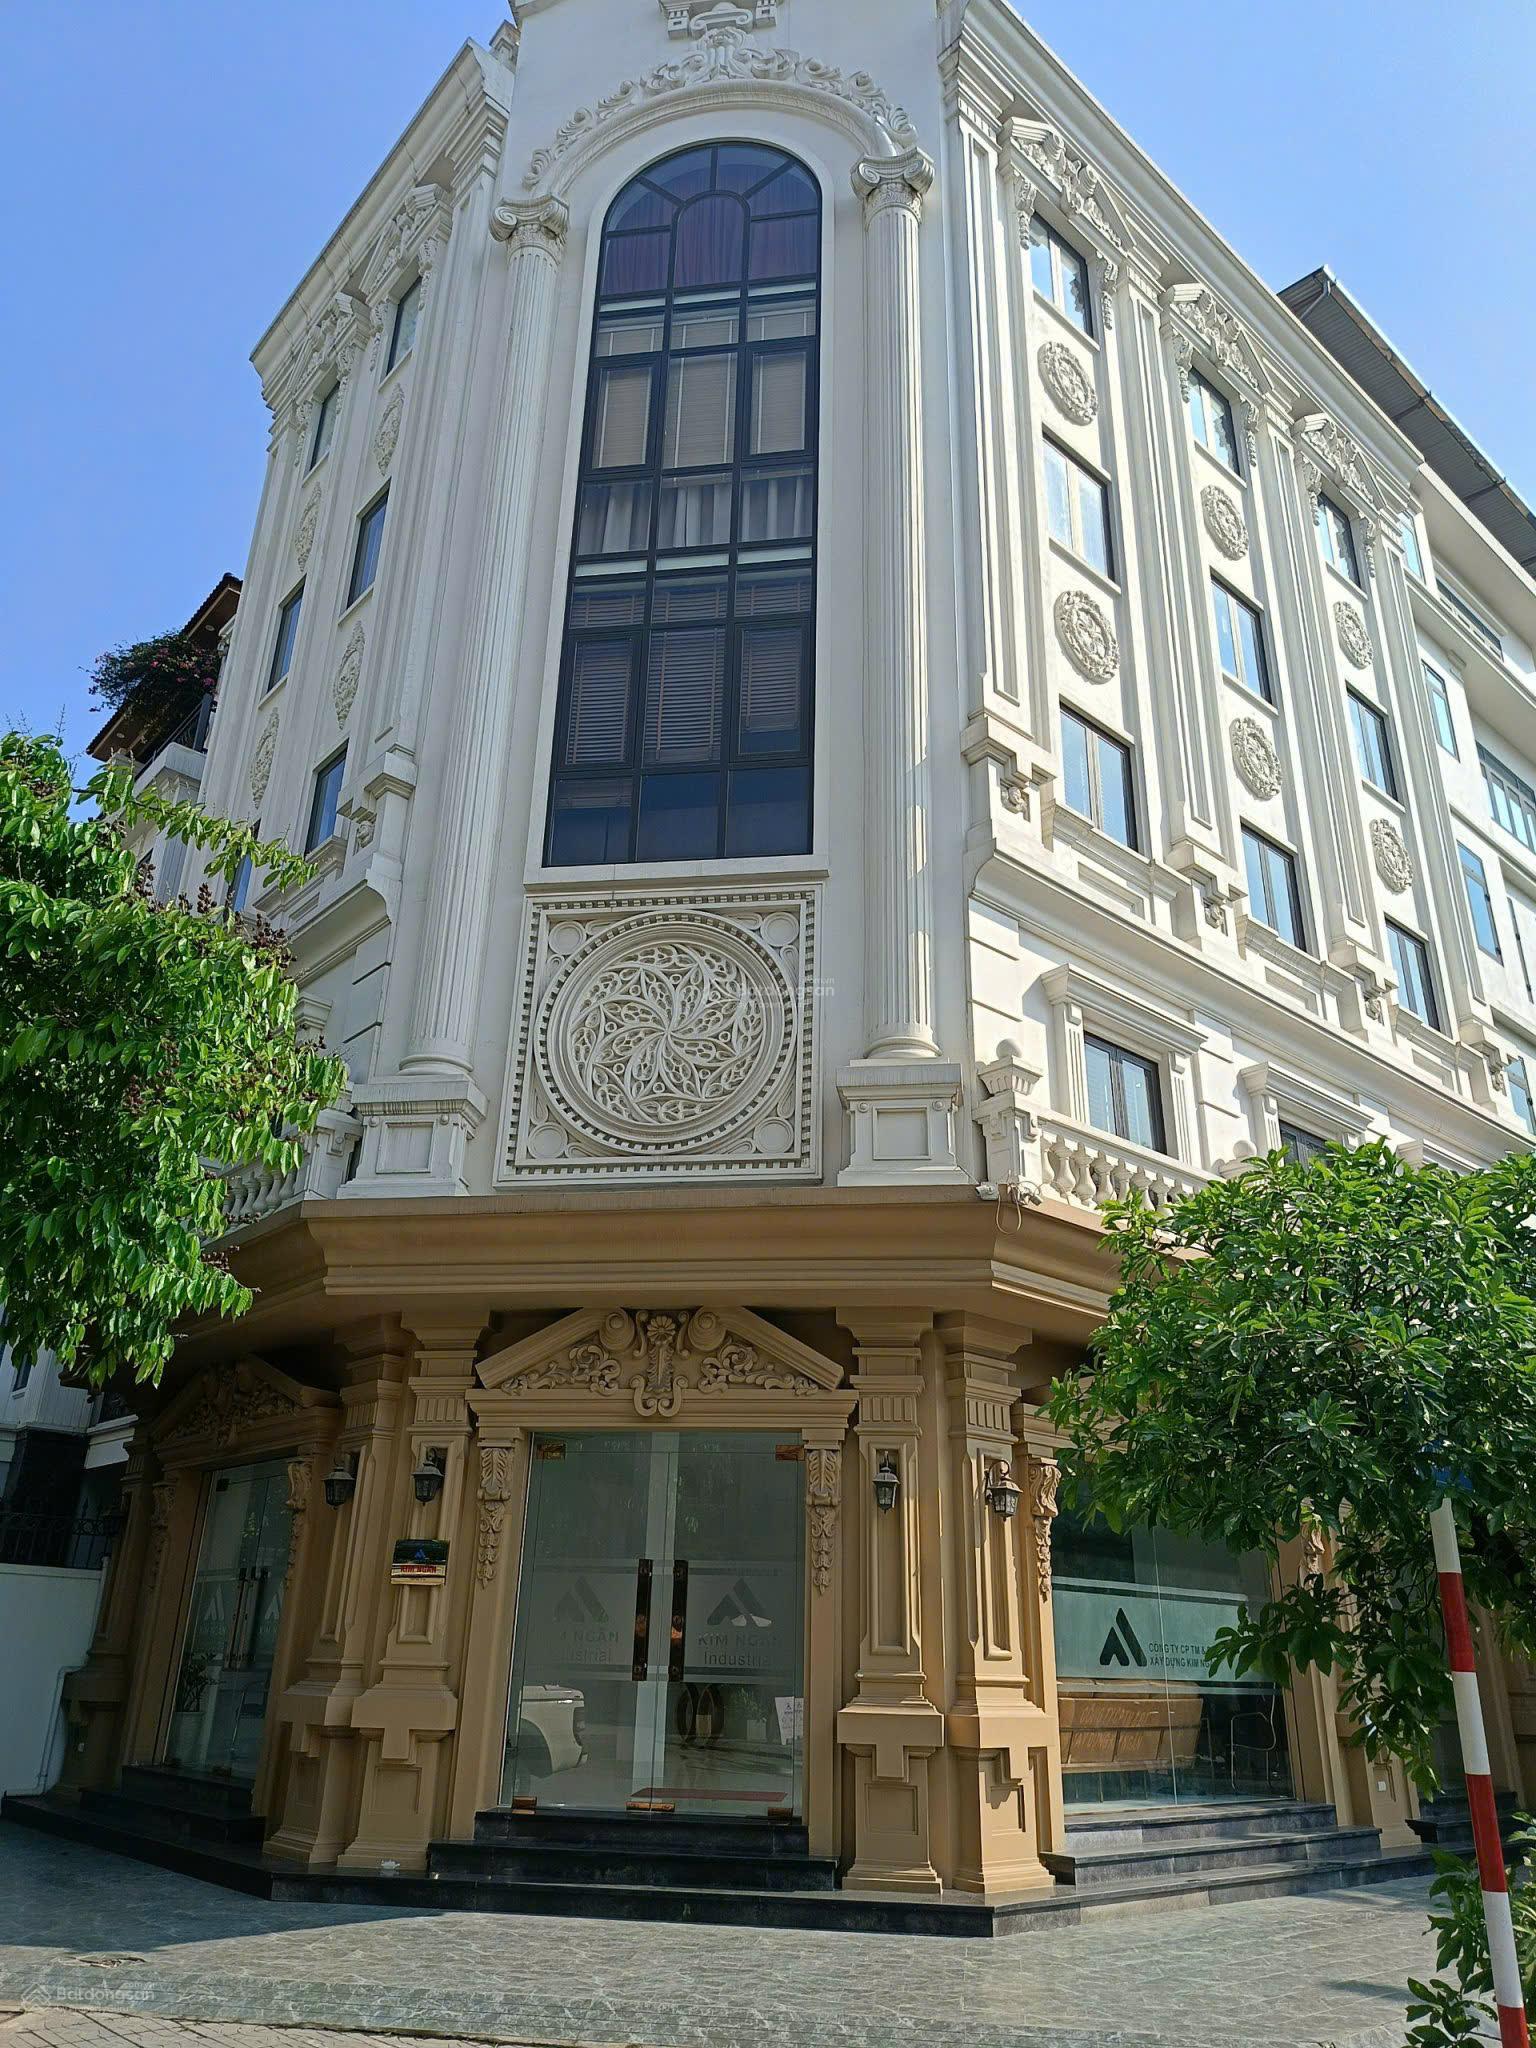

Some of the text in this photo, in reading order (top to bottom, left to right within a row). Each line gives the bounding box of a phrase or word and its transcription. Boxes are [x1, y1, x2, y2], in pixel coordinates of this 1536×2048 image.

[696, 1632, 728, 1646] KIM
[1170, 1644, 1179, 1654] TY
[1190, 1645, 1200, 1655] TM
